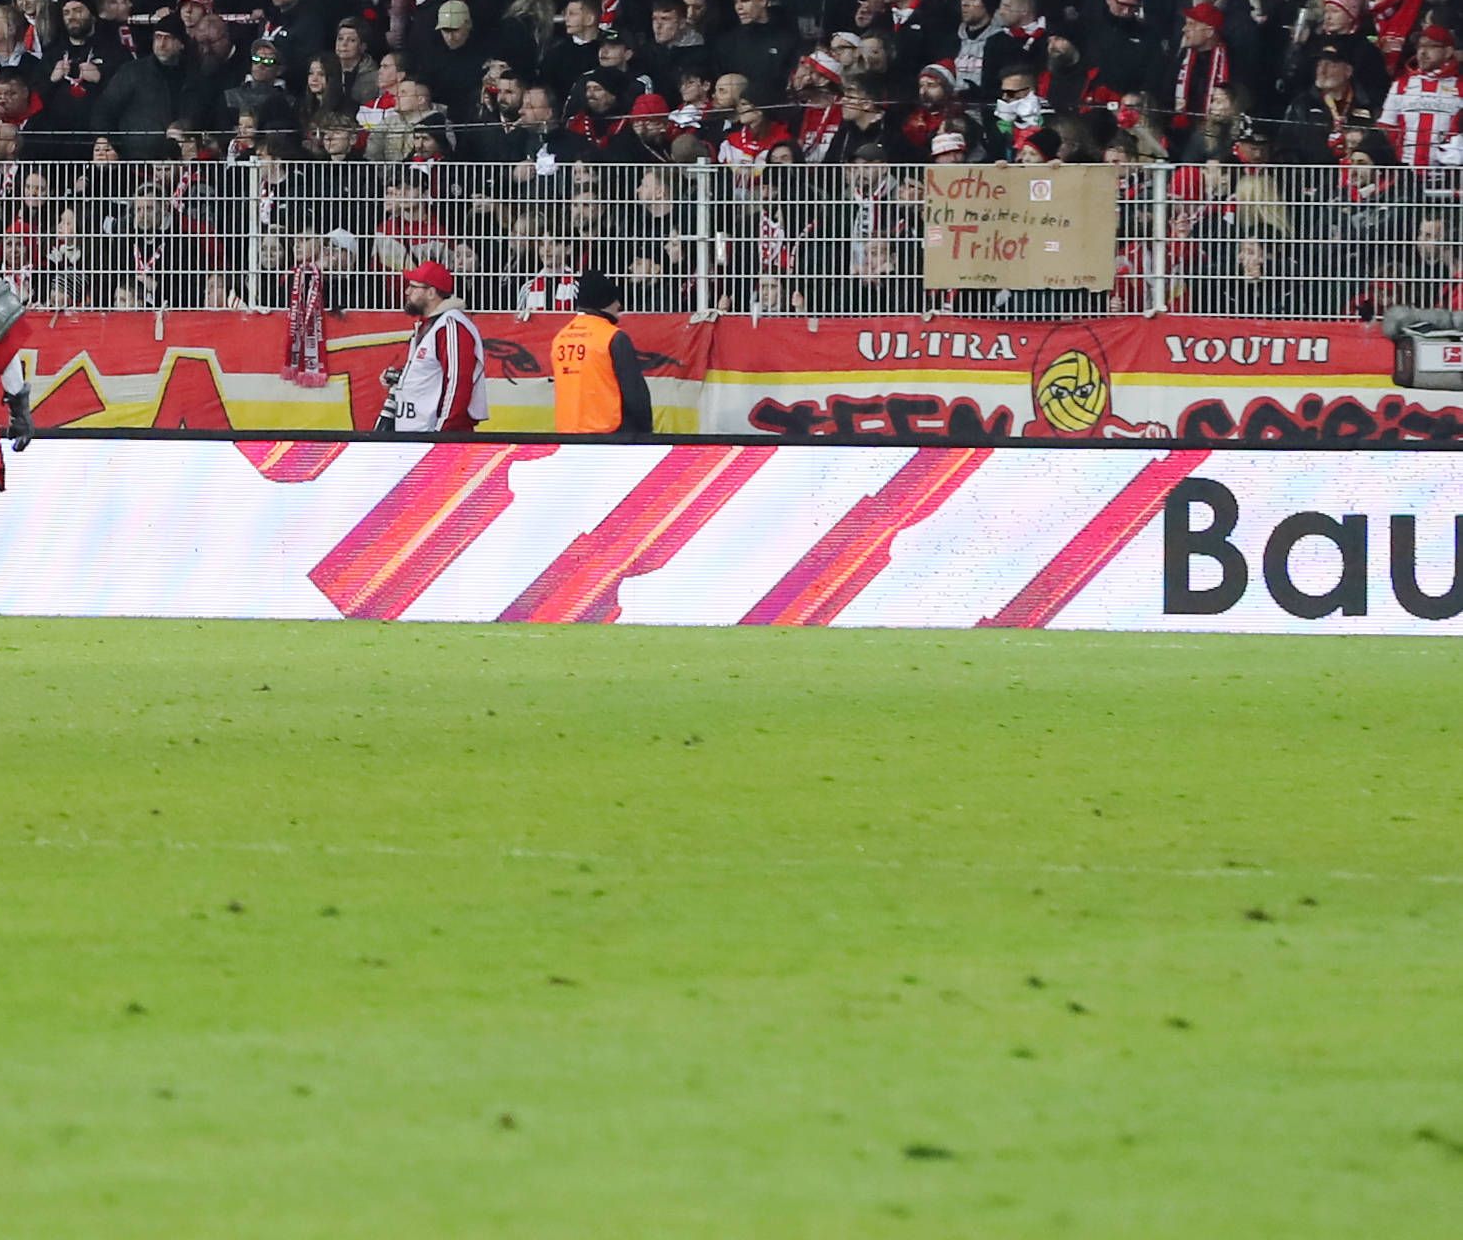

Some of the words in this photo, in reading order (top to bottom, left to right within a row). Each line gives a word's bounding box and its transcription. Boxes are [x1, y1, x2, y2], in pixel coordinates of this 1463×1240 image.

[948, 225, 1030, 261] Trikot
[557, 344, 586, 361] 379
[1164, 335, 1330, 364] YOUTH
